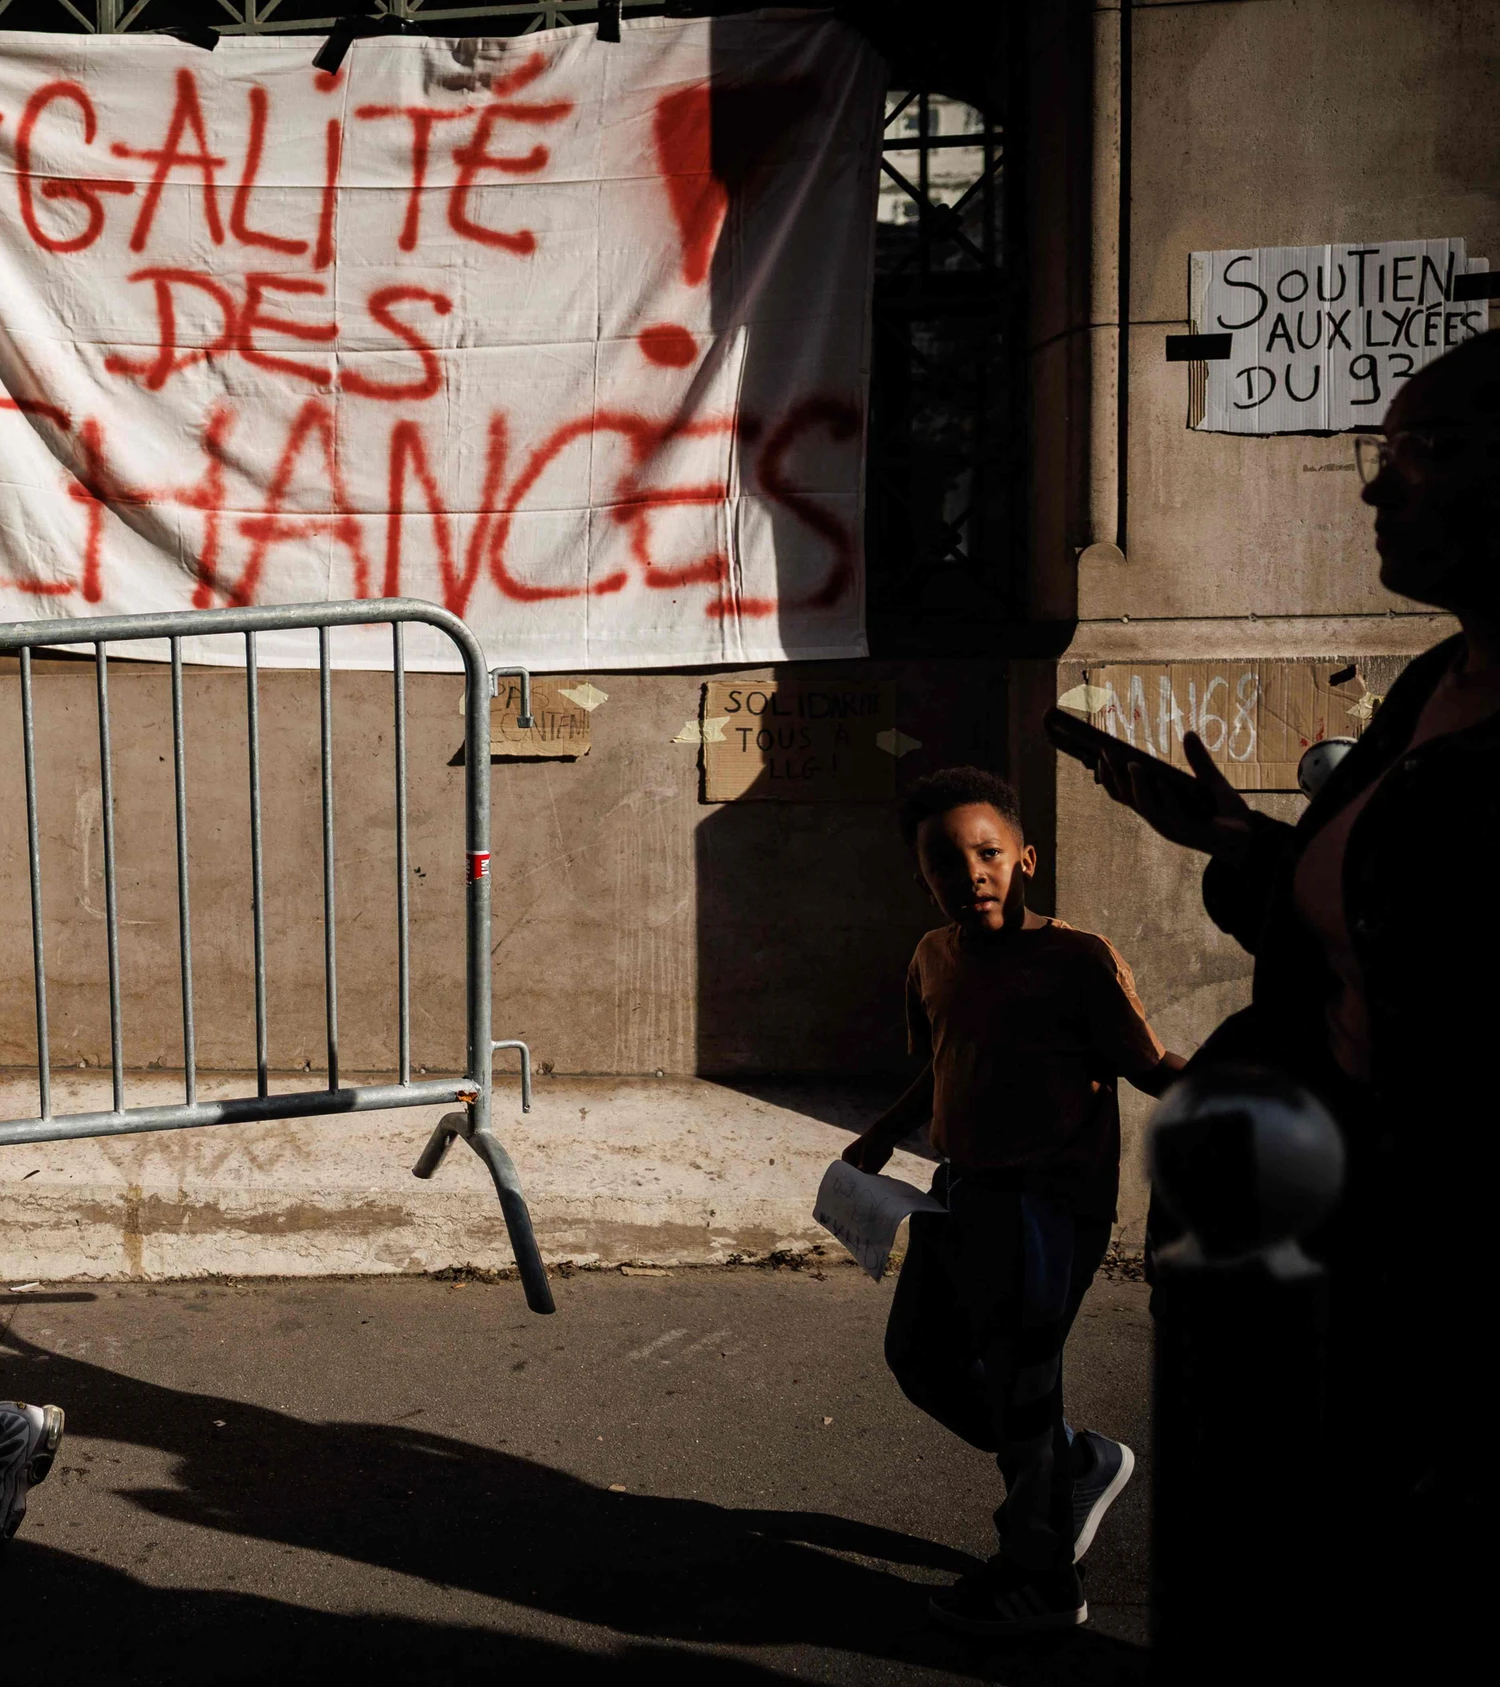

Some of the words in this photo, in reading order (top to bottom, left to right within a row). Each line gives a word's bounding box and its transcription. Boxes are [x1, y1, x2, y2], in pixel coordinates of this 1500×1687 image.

[638, 78, 822, 366] !
[1217, 249, 1455, 329] SOUTIEN
[104, 266, 452, 404] DES
[1265, 310, 1351, 354] AUX
[1366, 301, 1482, 348] LYCÉES
[1233, 363, 1320, 409] DU
[735, 727, 812, 752] TOUS
